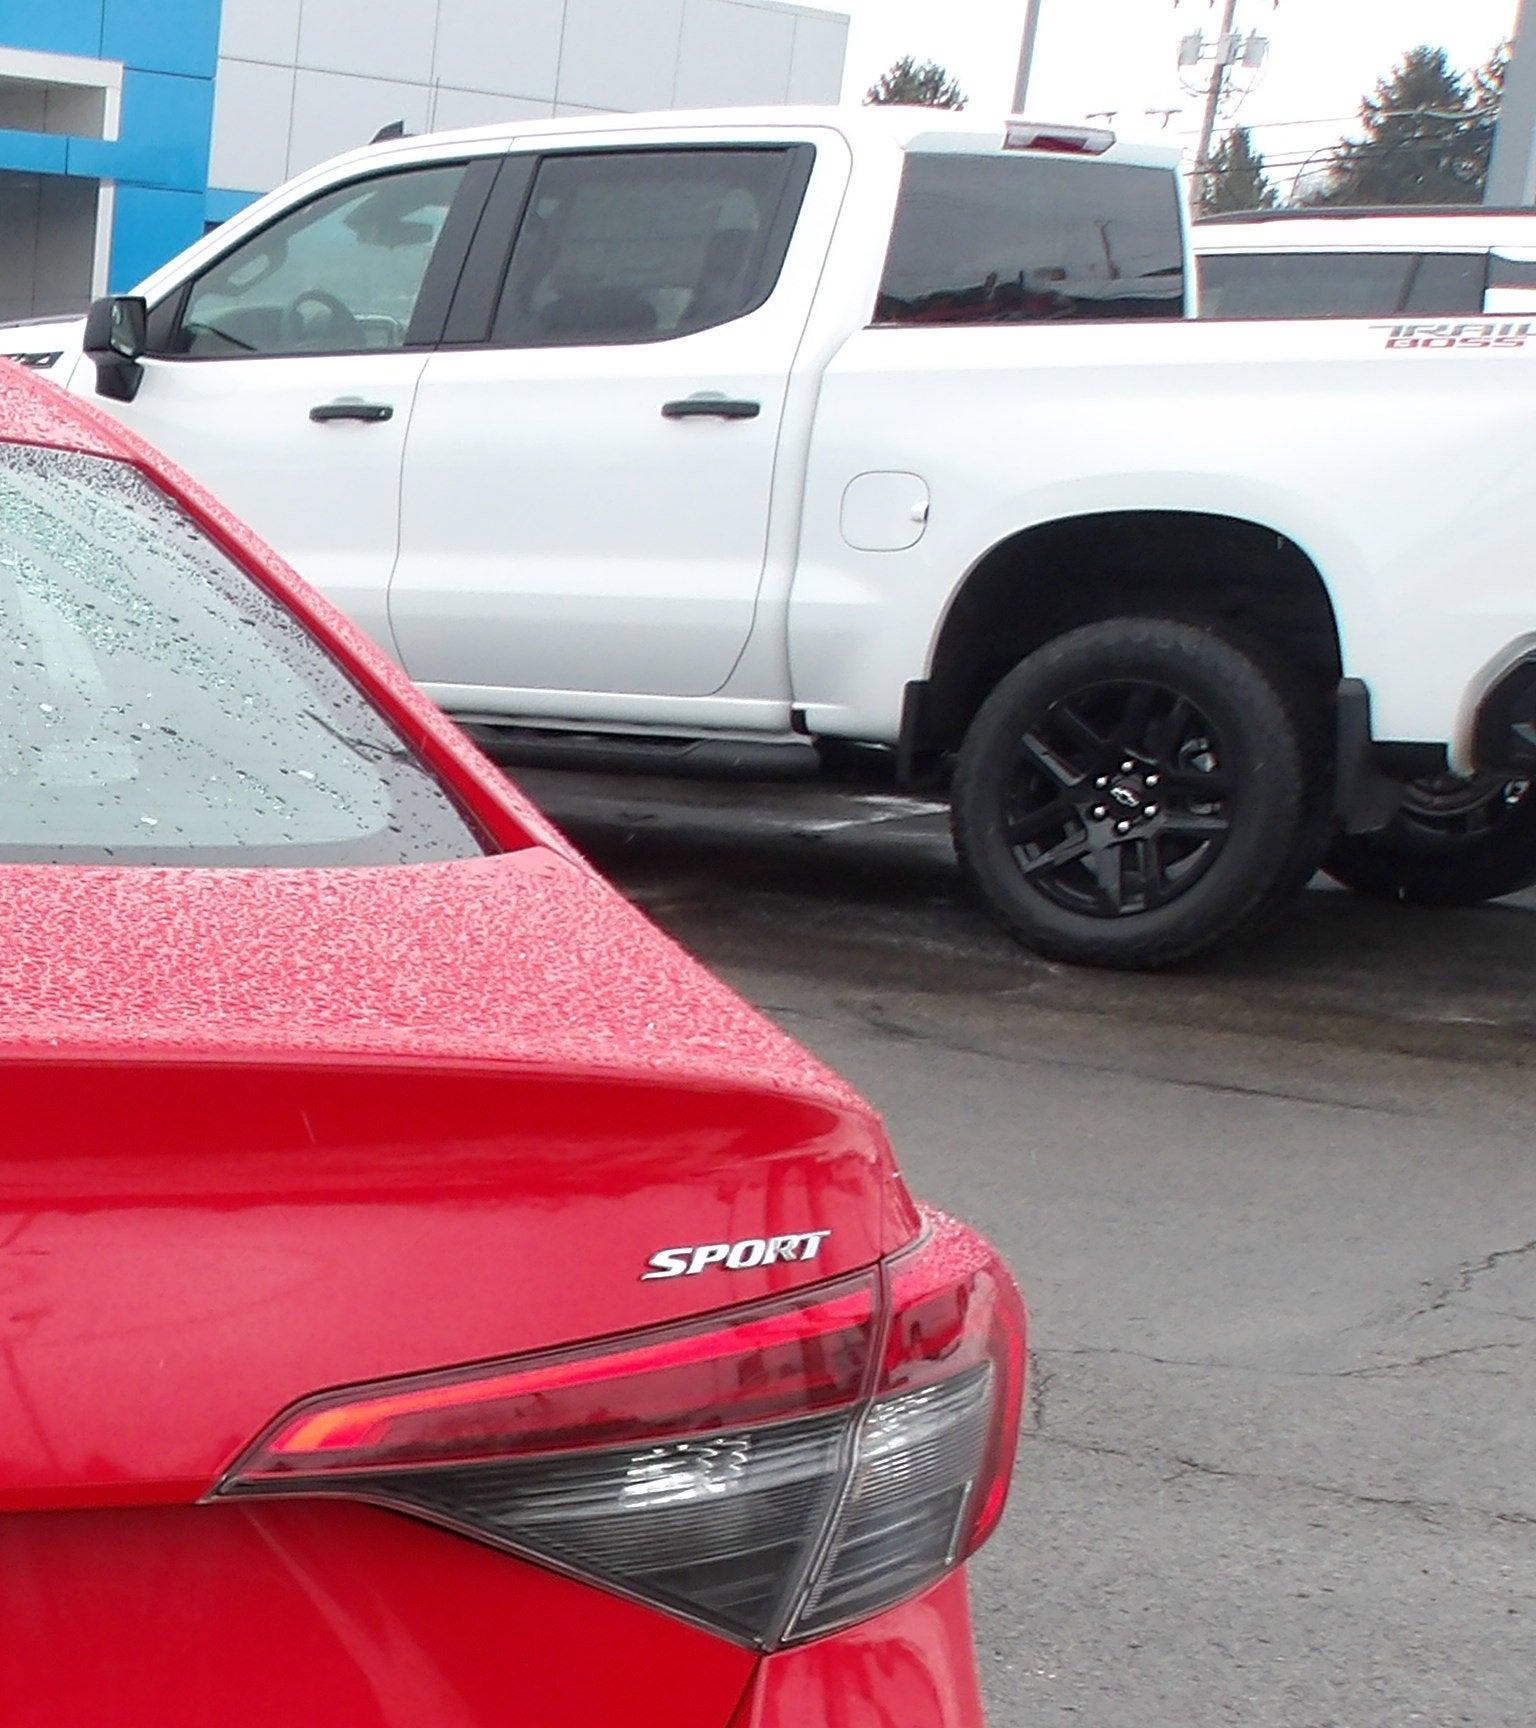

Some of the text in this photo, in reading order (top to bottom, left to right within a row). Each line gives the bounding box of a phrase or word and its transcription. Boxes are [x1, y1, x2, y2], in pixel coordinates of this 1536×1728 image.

[1368, 323, 1536, 338] TRAIL
[1385, 337, 1525, 349] BOSS
[640, 1229, 832, 1281] SPORT
